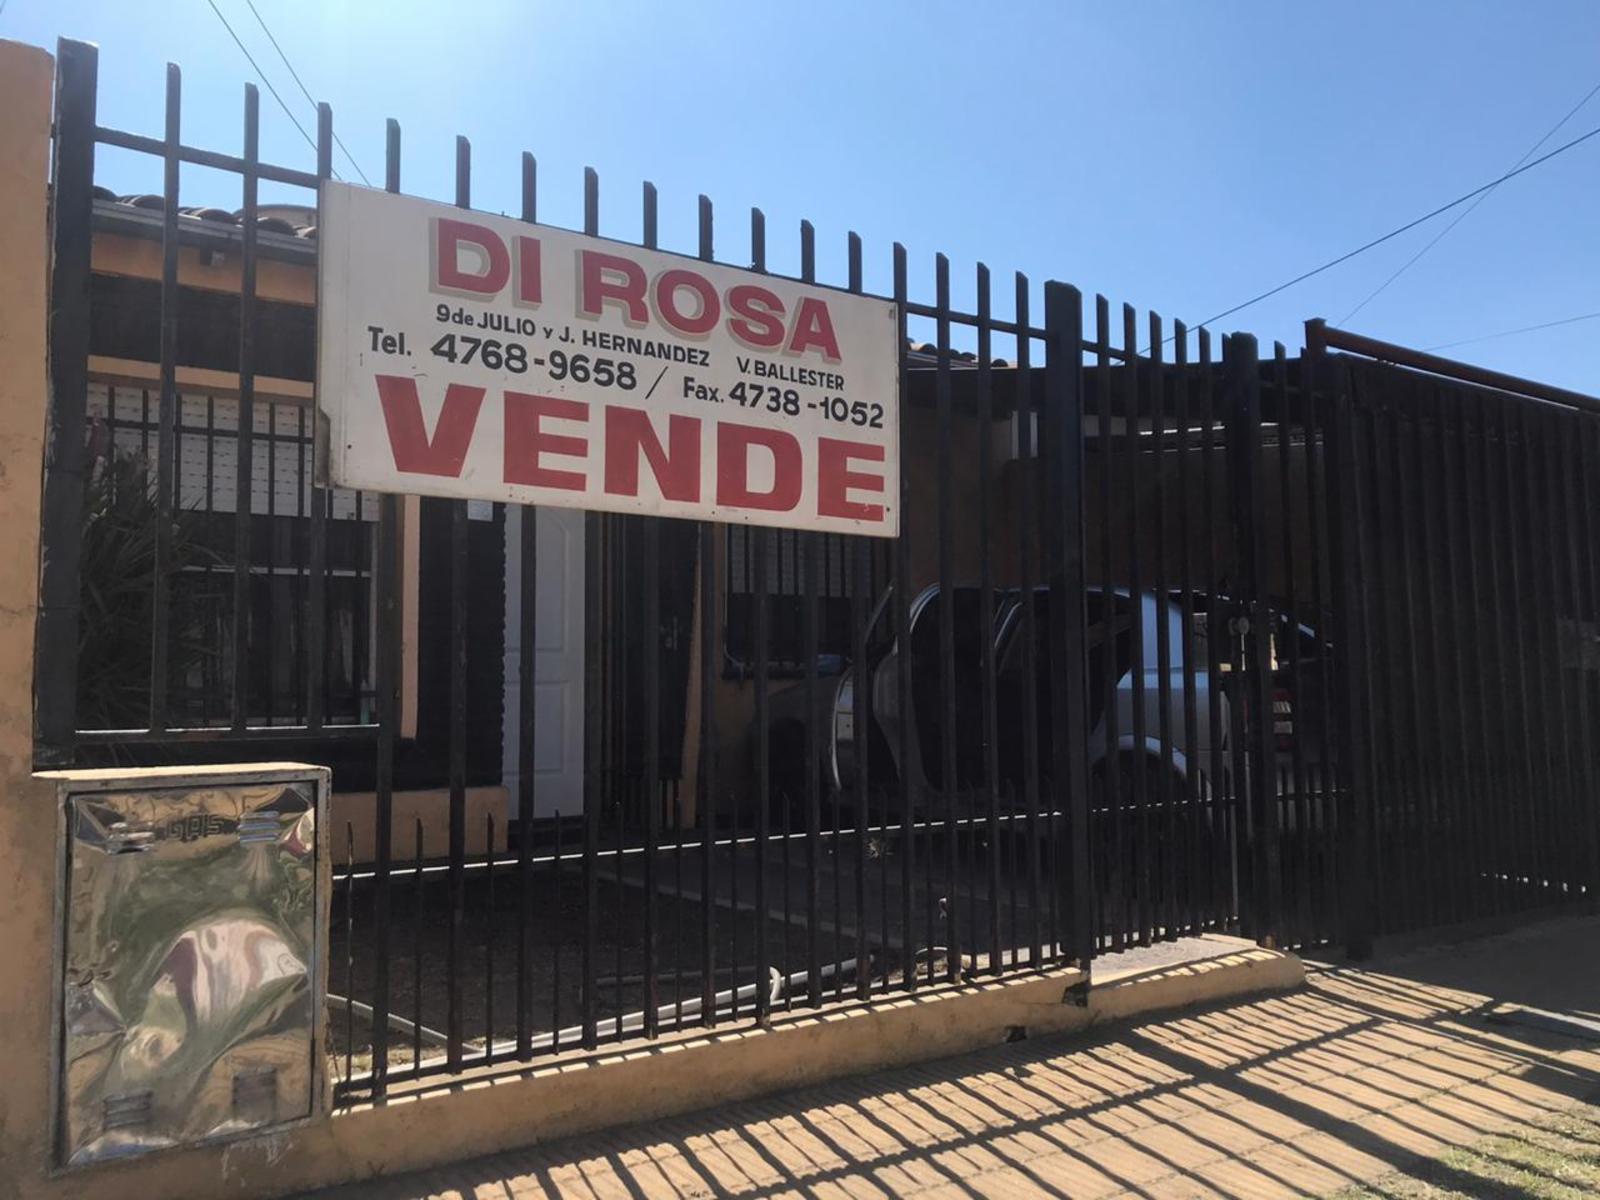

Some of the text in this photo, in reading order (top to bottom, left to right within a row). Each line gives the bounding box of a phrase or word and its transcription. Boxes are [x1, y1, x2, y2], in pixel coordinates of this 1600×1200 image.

[429, 217, 842, 365] DI ROSA
[477, 312, 536, 336] JULIO
[582, 330, 710, 367] HERNANDEZ
[368, 326, 411, 356] Tel.
[683, 376, 724, 403] Fax.
[374, 373, 885, 522] VENDE
